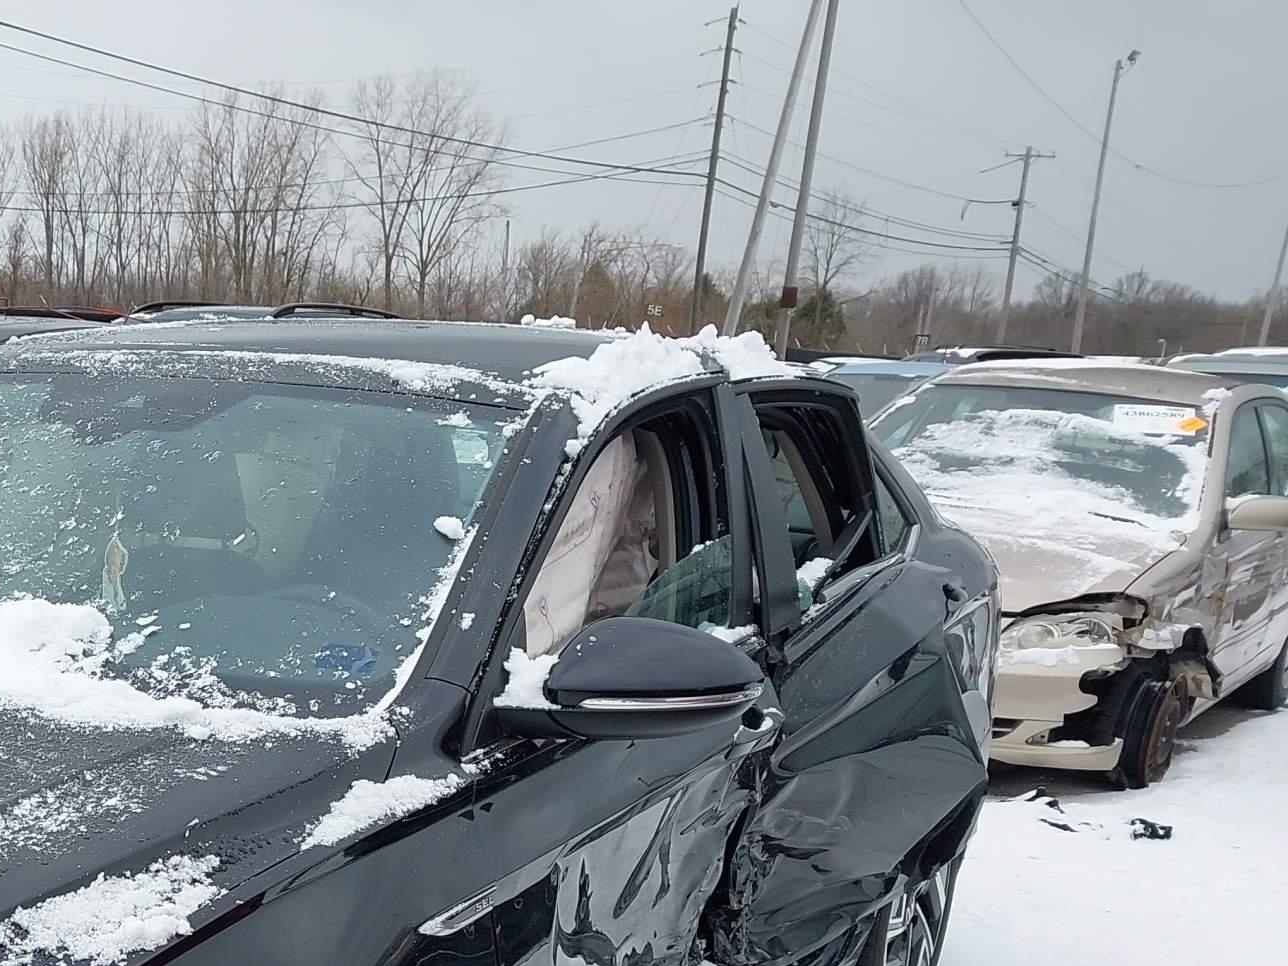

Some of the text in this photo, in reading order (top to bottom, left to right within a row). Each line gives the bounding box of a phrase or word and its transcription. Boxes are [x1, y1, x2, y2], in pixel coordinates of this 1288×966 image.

[647, 304, 663, 316] 5E
[916, 335, 928, 345] 7R
[475, 896, 495, 912] SEL
